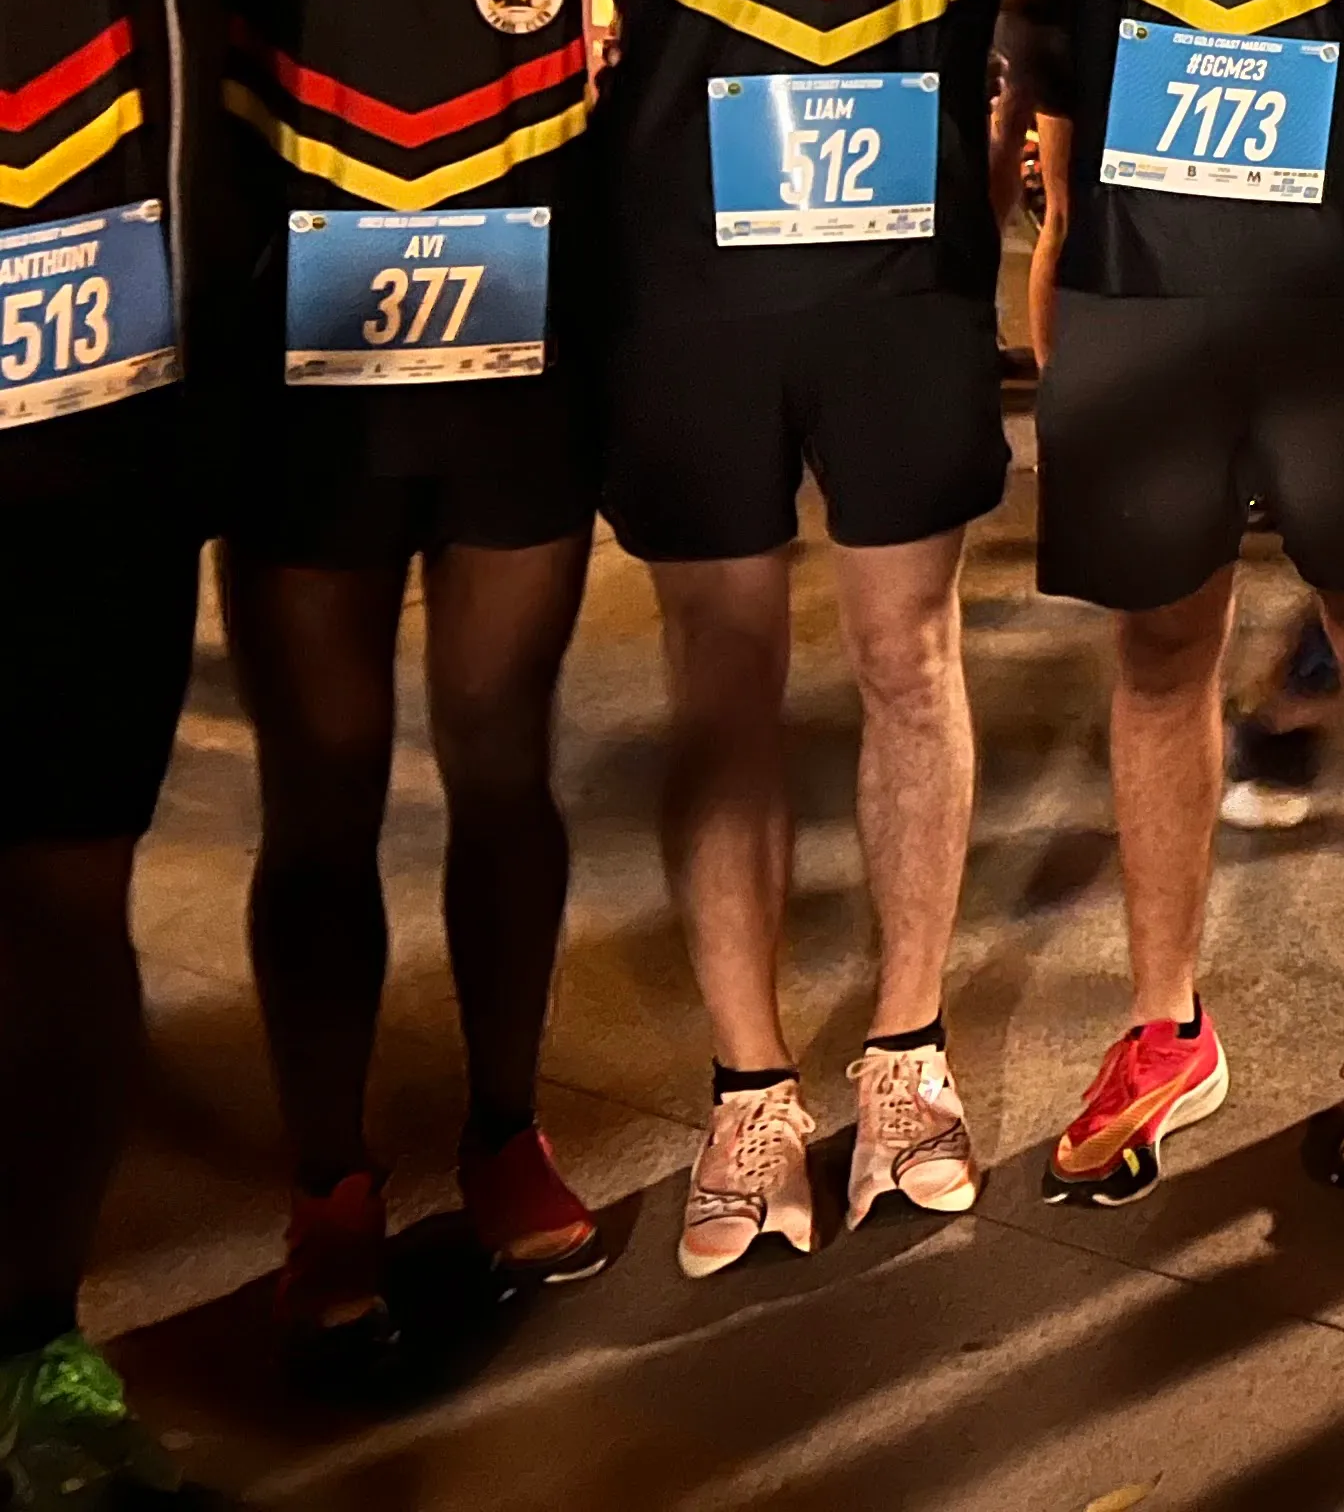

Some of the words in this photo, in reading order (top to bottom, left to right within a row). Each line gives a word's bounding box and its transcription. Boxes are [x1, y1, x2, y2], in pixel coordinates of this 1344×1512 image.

[1185, 52, 1269, 82] #GCM23
[803, 97, 856, 121] LIAM
[1155, 80, 1288, 162] 7173
[779, 127, 881, 205] 512
[1246, 170, 1262, 184] M
[0, 239, 99, 287] ANTHONY
[403, 234, 446, 260] AVI
[1, 275, 110, 381] 513
[362, 264, 485, 345] 377
